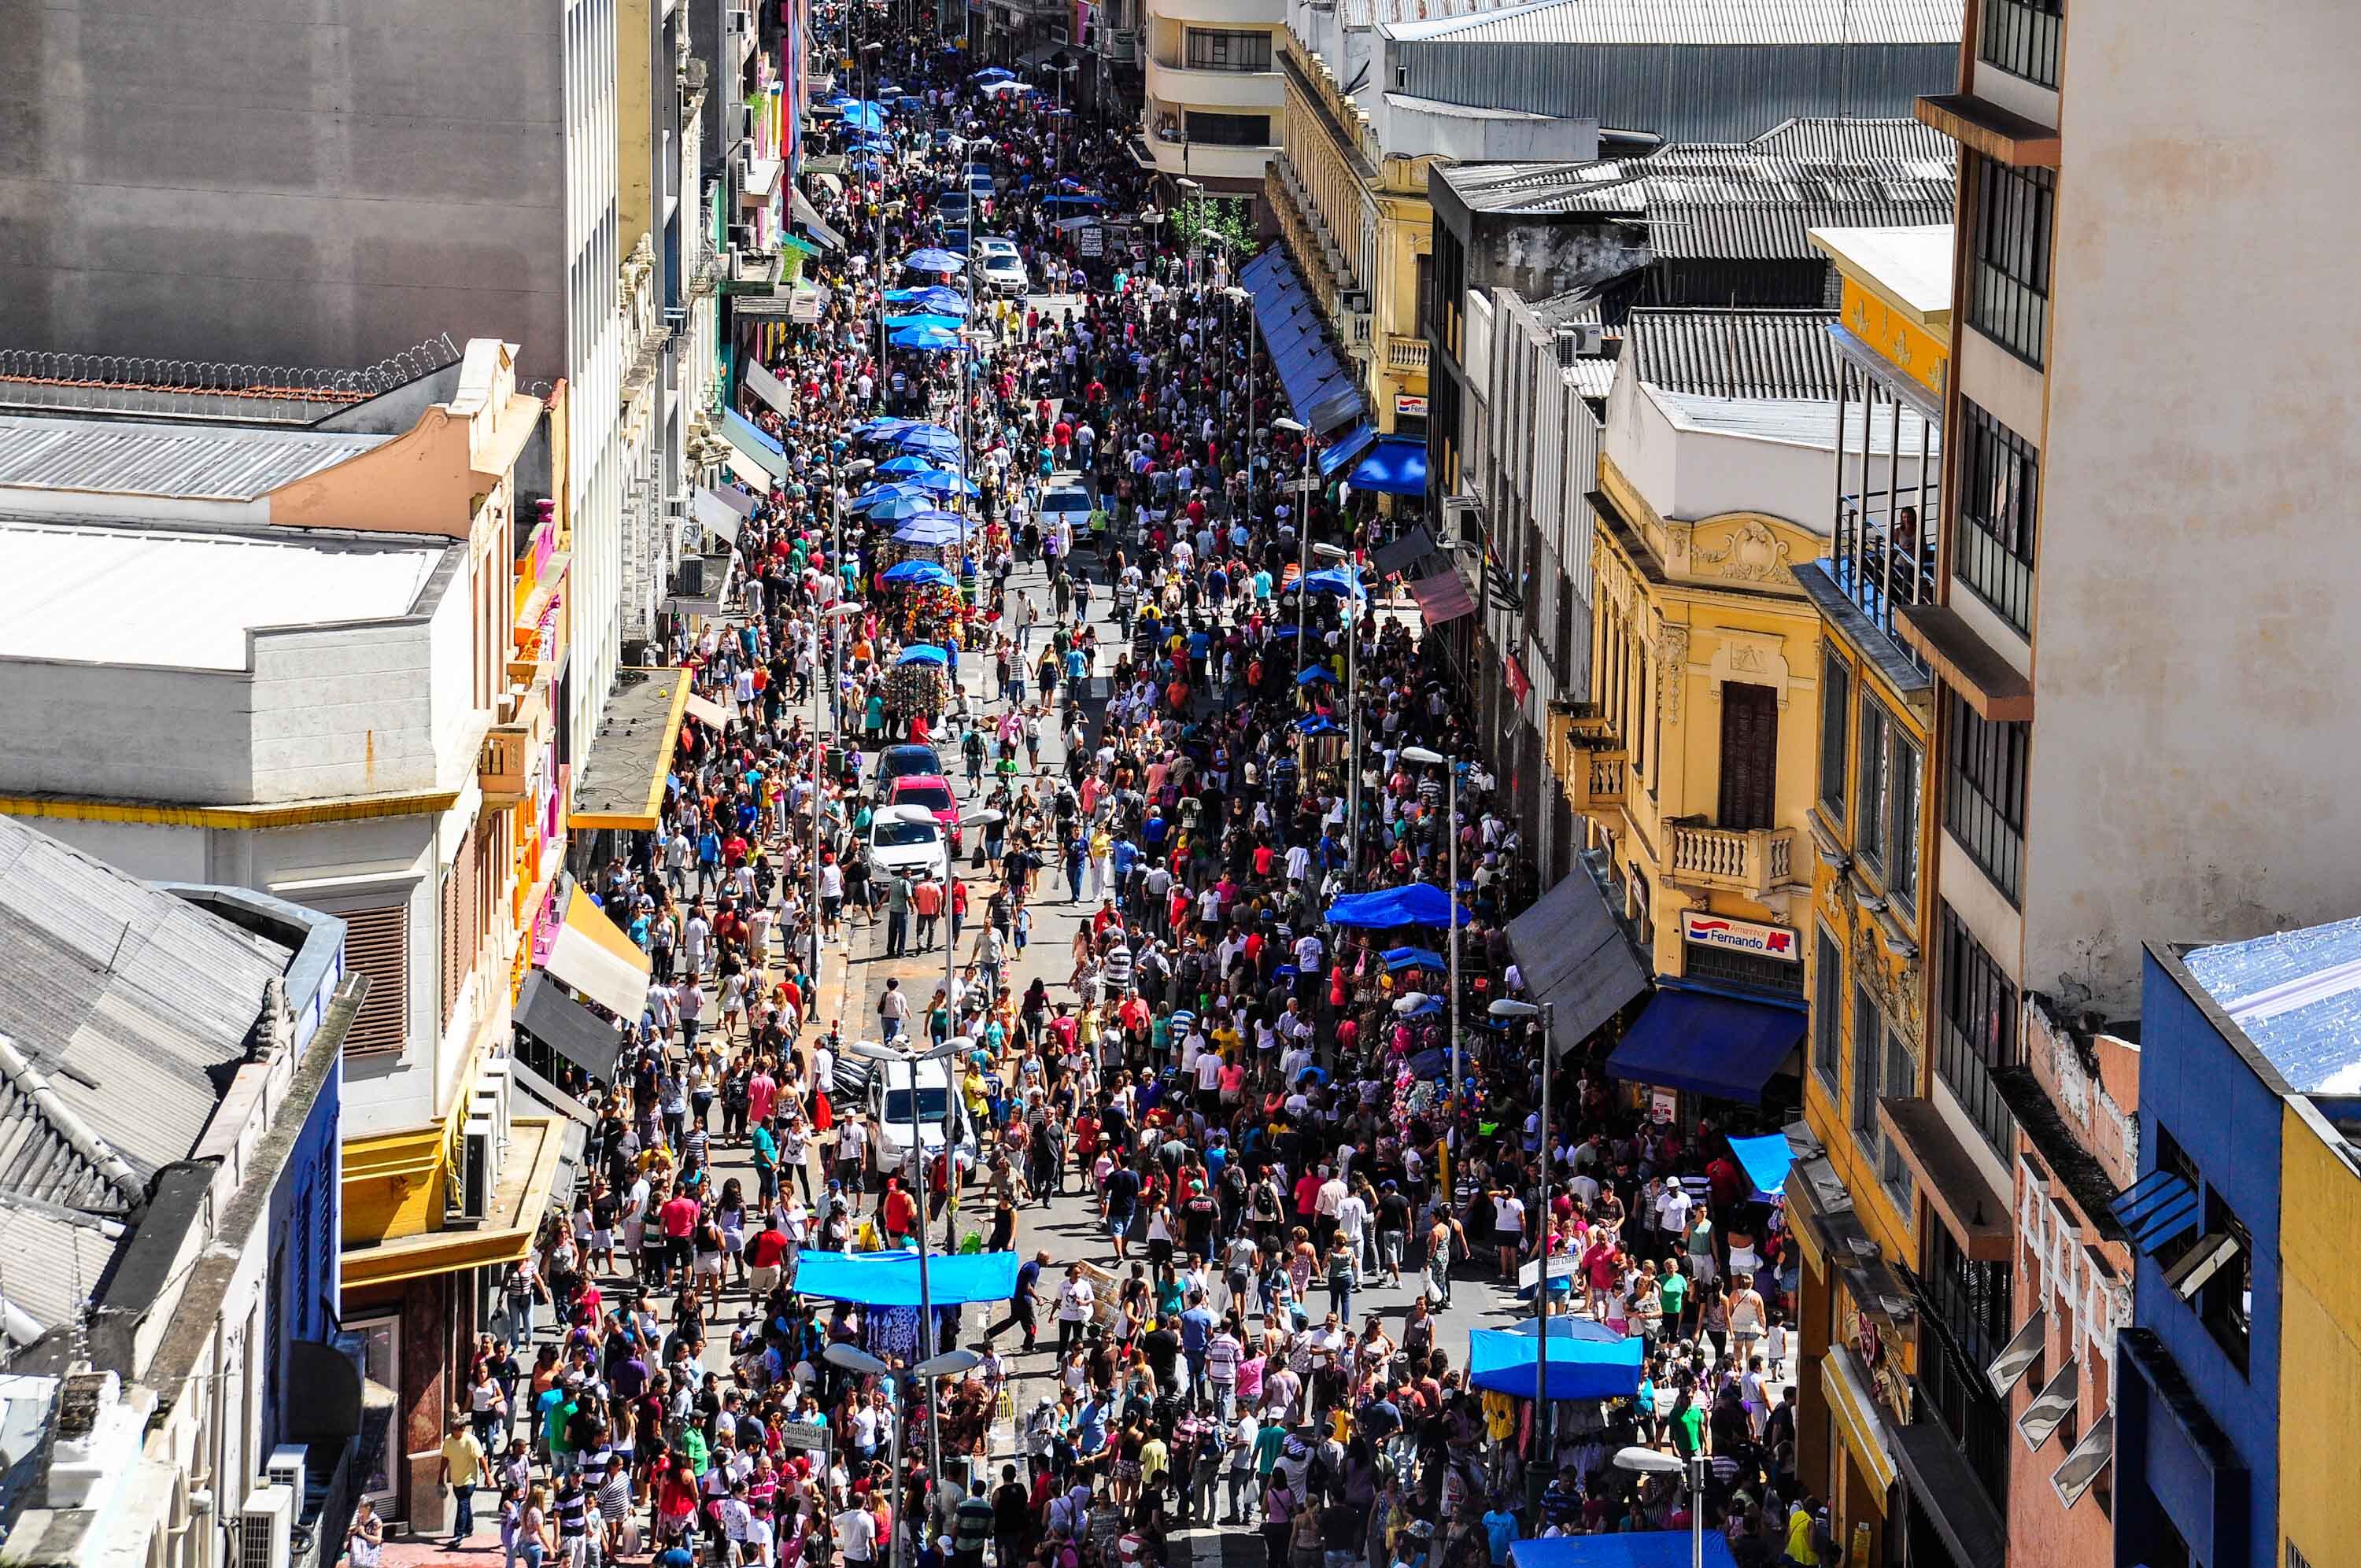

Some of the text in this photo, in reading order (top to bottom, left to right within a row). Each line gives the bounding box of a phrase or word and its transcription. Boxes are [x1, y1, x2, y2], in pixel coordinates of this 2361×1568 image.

[1731, 924, 1766, 937] Armarinhos
[1710, 930, 1763, 949] Fernando
[1765, 932, 1790, 953] AF
[783, 1424, 822, 1440] Constituição
